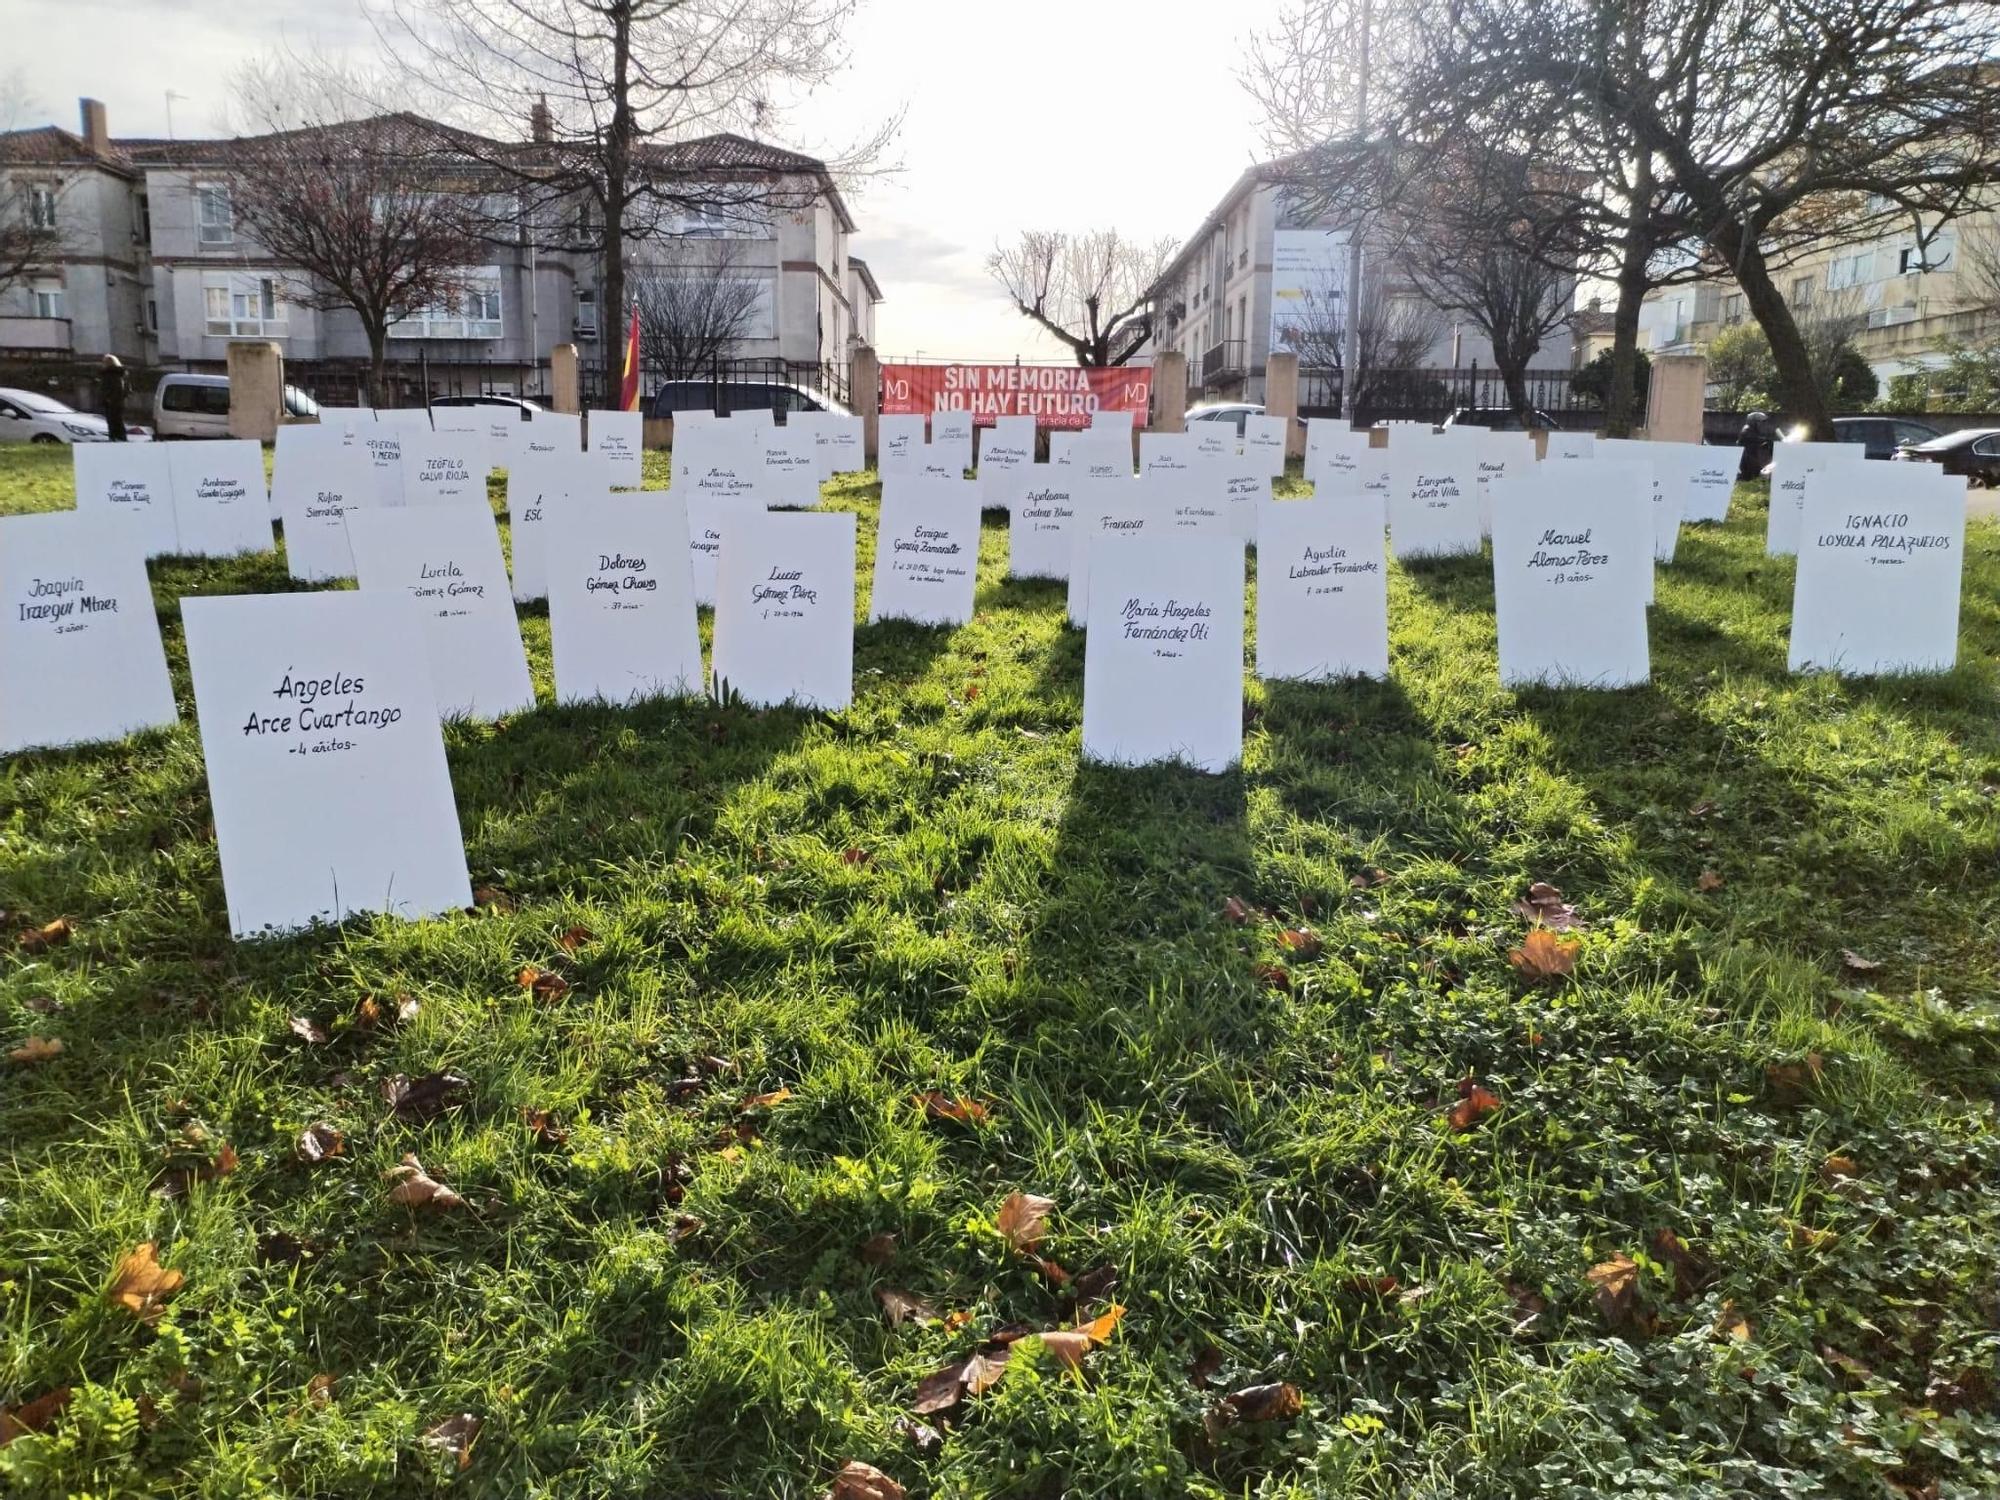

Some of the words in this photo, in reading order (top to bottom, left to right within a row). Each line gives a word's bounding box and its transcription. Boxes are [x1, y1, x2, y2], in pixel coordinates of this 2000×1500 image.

[945, 367, 980, 389] SIN
[987, 368, 1090, 391] MEMORIA
[886, 380, 908, 400] MD
[1124, 383, 1147, 403] MD
[934, 391, 964, 412] NO
[971, 392, 1011, 414] HAY
[1017, 393, 1099, 415] FUTURO
[1441, 486, 1460, 497] Villa
[1845, 513, 1909, 530] IGNACIO
[914, 525, 949, 542] Enrique
[1538, 528, 1591, 546] Manuel
[1818, 534, 1866, 548] LOYOLA
[1870, 534, 1951, 555] PALAZUELOS
[598, 553, 646, 572] Dolores
[1527, 551, 1576, 568] Alonso
[1576, 550, 1608, 566] Pérez
[420, 561, 464, 579] Lucila
[767, 565, 803, 581] Lucio
[1289, 564, 1332, 579] Labrador
[447, 581, 485, 599] Gómez
[586, 576, 619, 595] Gómez
[752, 584, 789, 605] Gómez
[1120, 598, 1159, 620] María
[1161, 599, 1212, 621] Ángeles
[1124, 621, 1189, 643] Fernández
[273, 665, 365, 704] Ángeles
[243, 711, 292, 736] Arce
[299, 700, 402, 729] Cuartango
